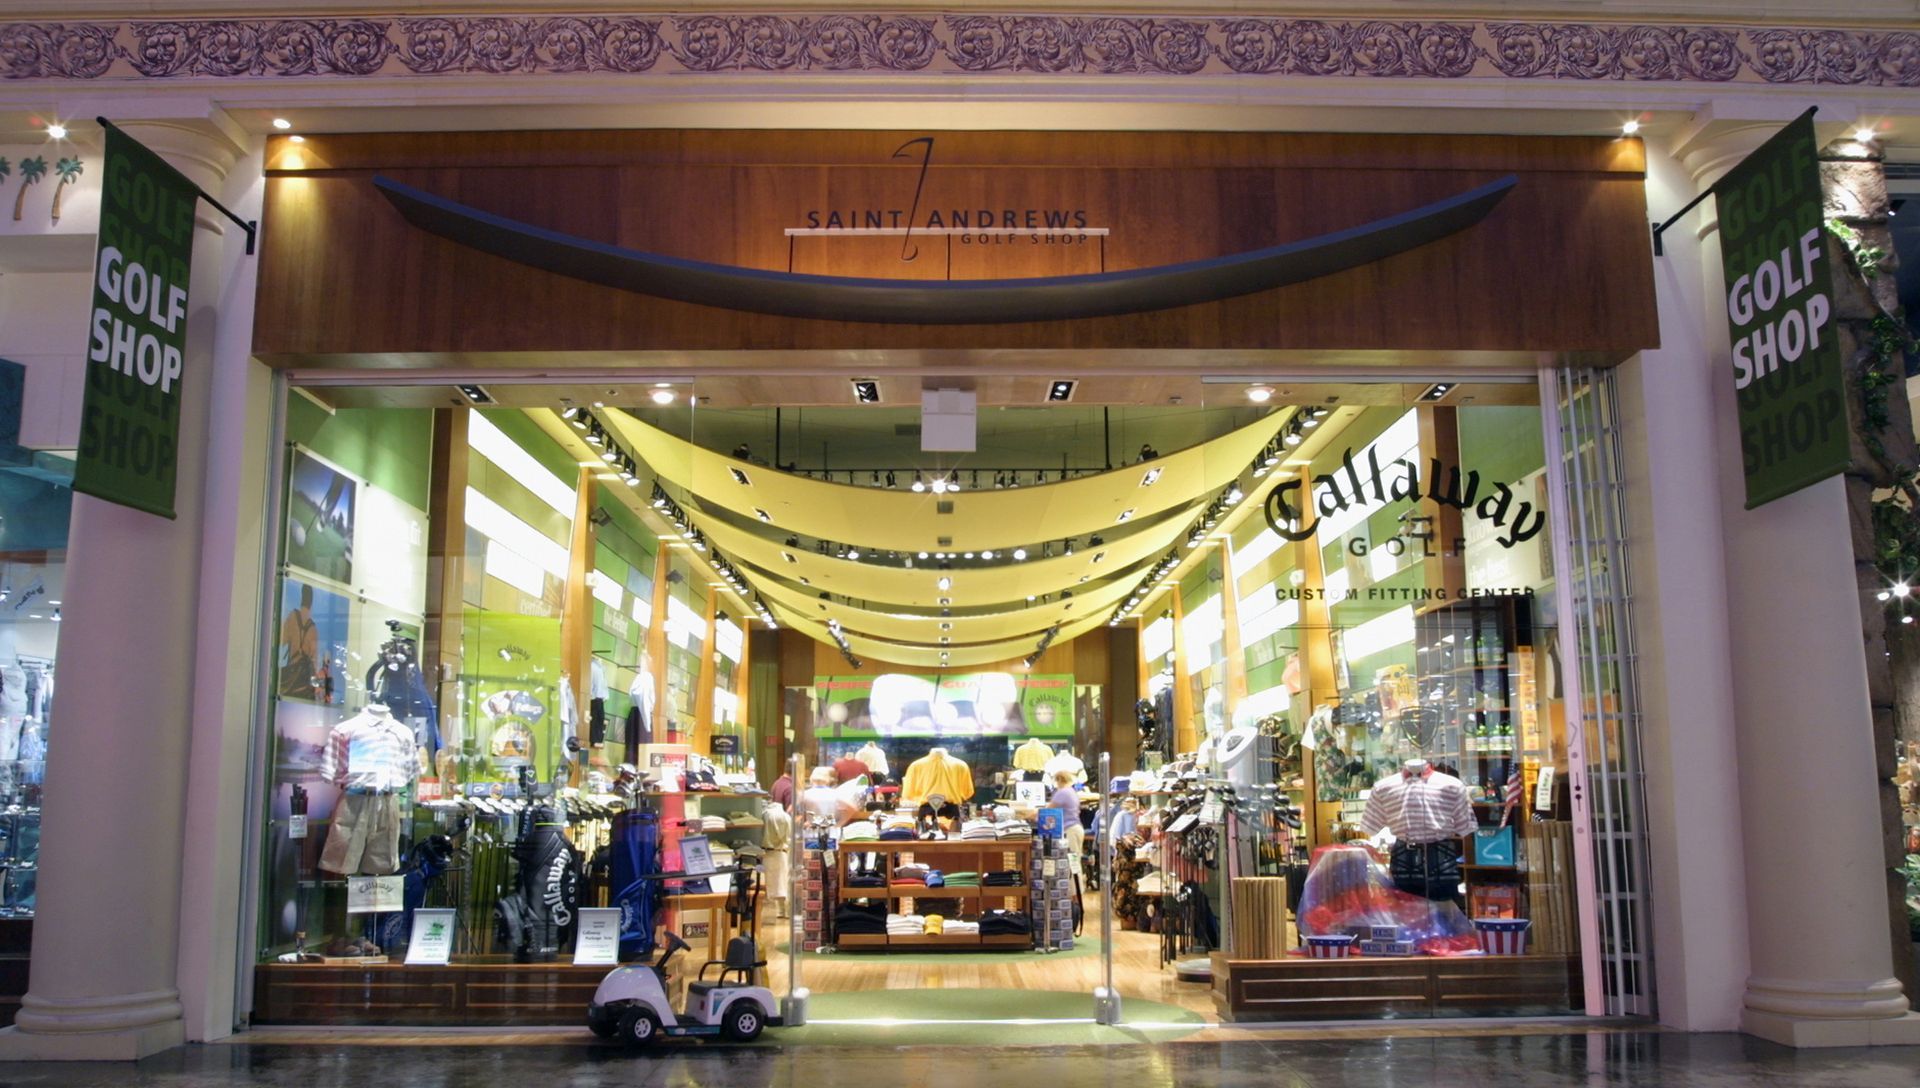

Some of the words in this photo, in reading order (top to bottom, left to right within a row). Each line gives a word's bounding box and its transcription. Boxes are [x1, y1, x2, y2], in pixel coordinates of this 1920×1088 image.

[107, 152, 197, 246] GOLF
[807, 210, 903, 229] SAINT
[926, 210, 1088, 229] ANDREWS
[1723, 136, 1812, 241] GOLF
[961, 233, 1016, 245] GOLF
[1031, 233, 1088, 245] SHOP
[1729, 227, 1821, 327] GOLF
[98, 246, 187, 334] GOLF
[90, 307, 182, 393] SHOP
[1732, 293, 1830, 390] SHOP
[83, 403, 176, 482] SHOP
[1744, 388, 1841, 477] SHOP
[1264, 443, 1546, 548] Callaway
[1349, 537, 1466, 557] GOLF
[1275, 588, 1358, 601] CUSTOM
[1368, 588, 1447, 600] FITTING
[1458, 587, 1535, 600] CENTER
[543, 847, 572, 926] Callaway
